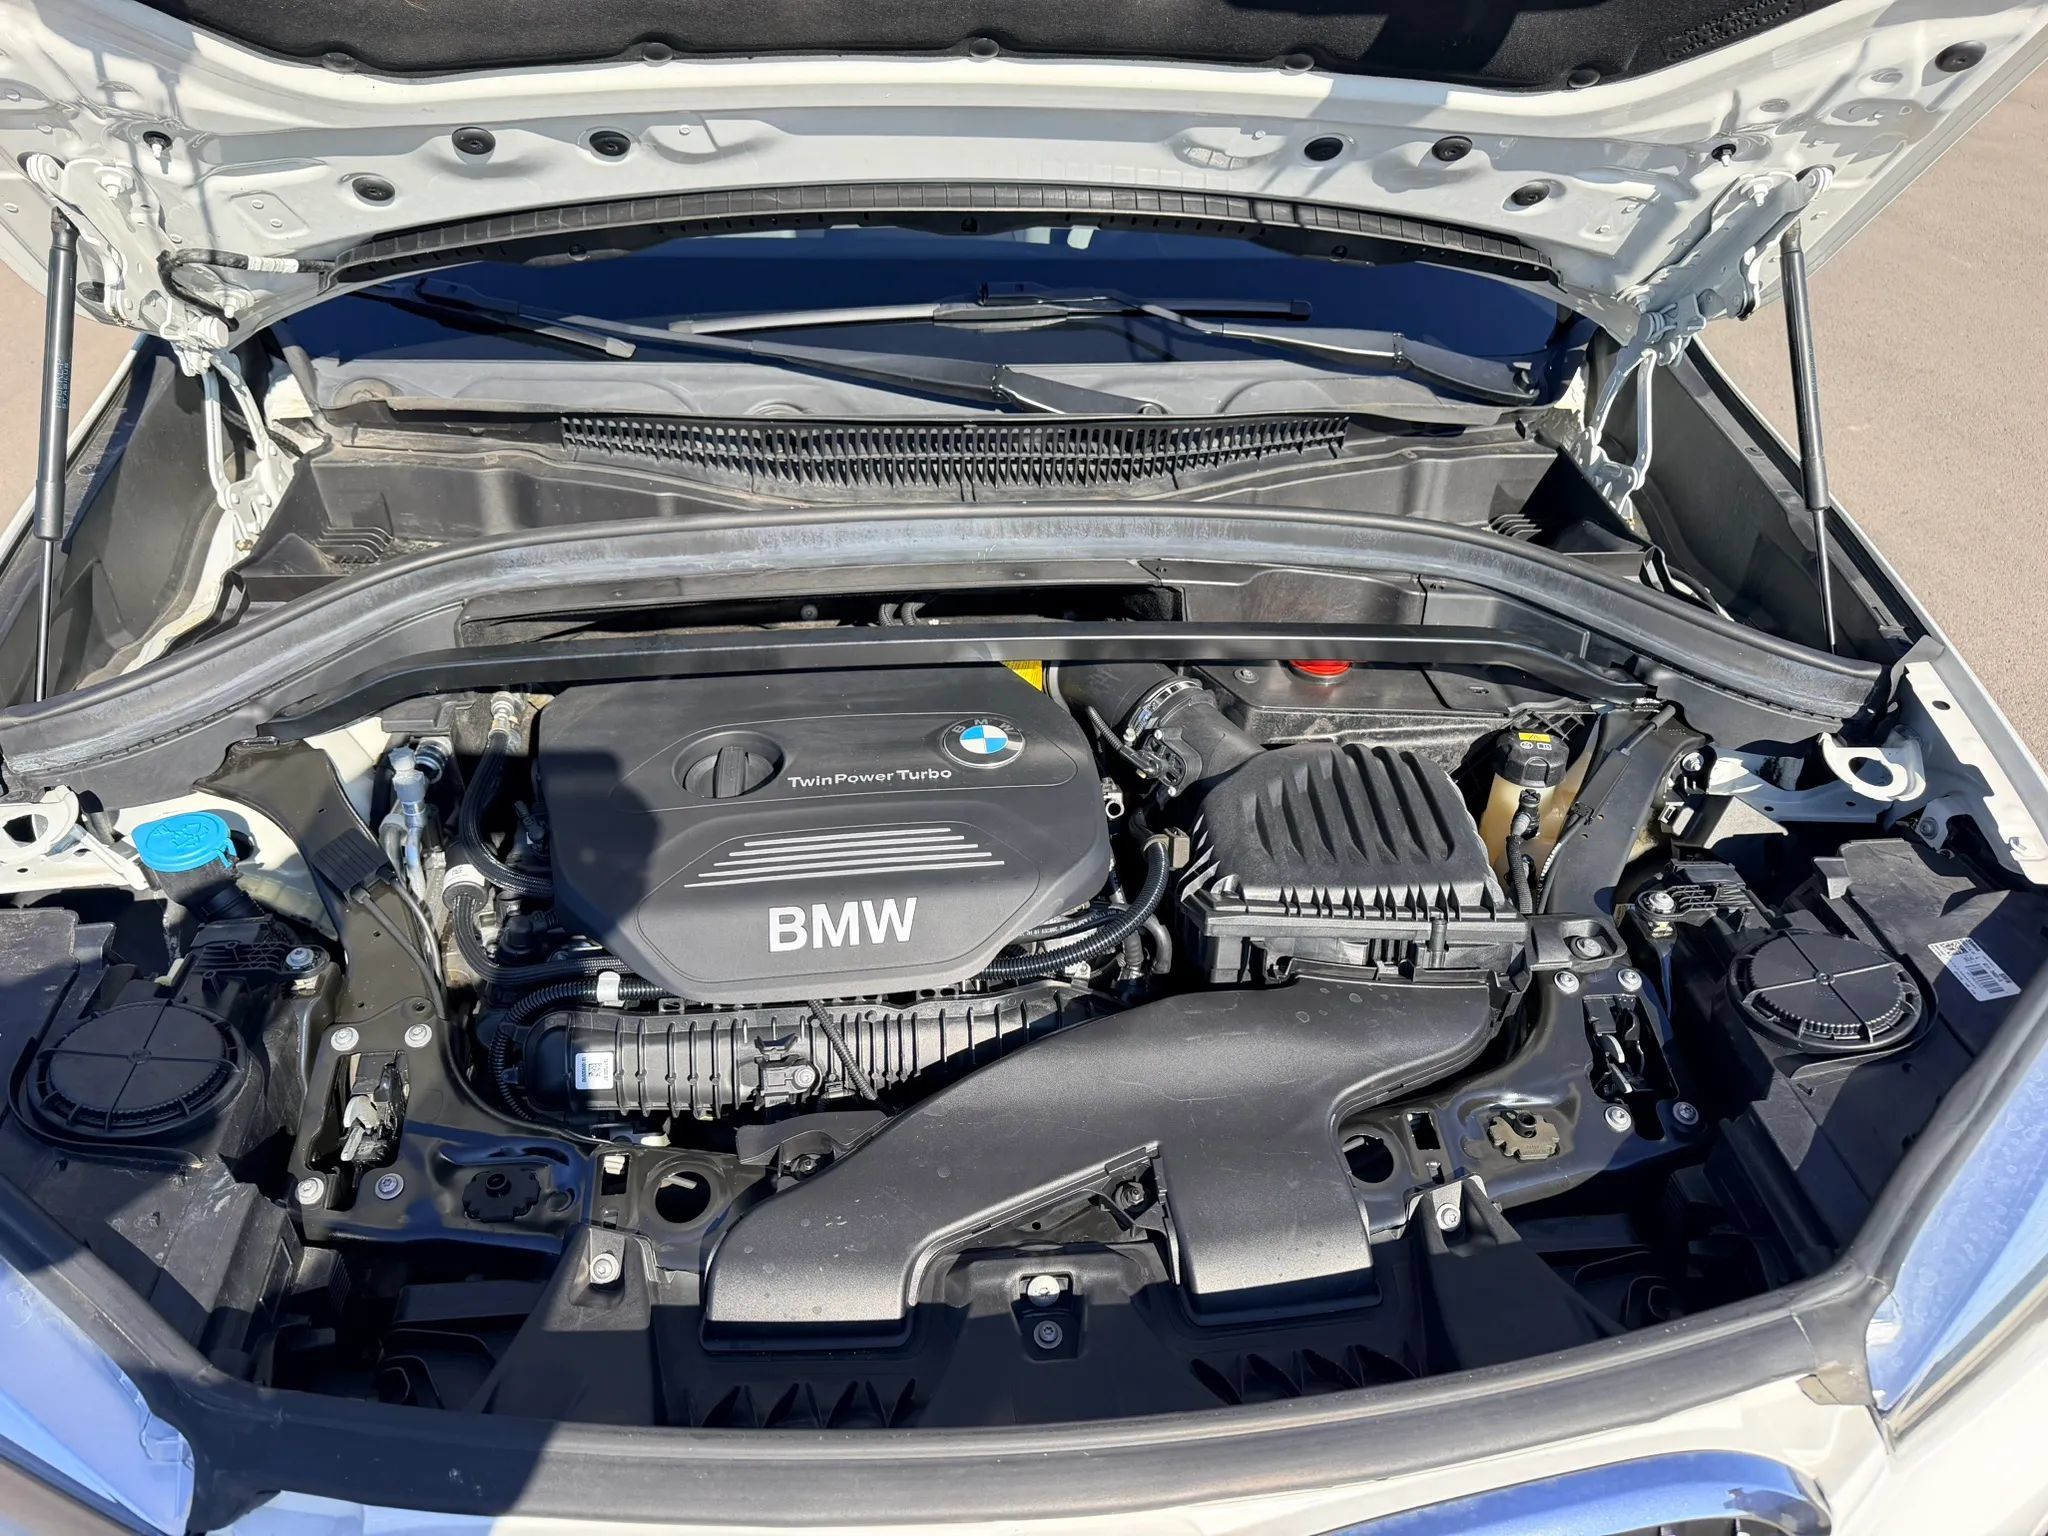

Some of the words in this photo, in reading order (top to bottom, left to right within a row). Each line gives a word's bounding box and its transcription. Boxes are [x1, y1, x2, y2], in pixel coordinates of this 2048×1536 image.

[951, 718, 1021, 736] BMW
[896, 768, 952, 781] Turbo
[768, 896, 918, 953] BMW
